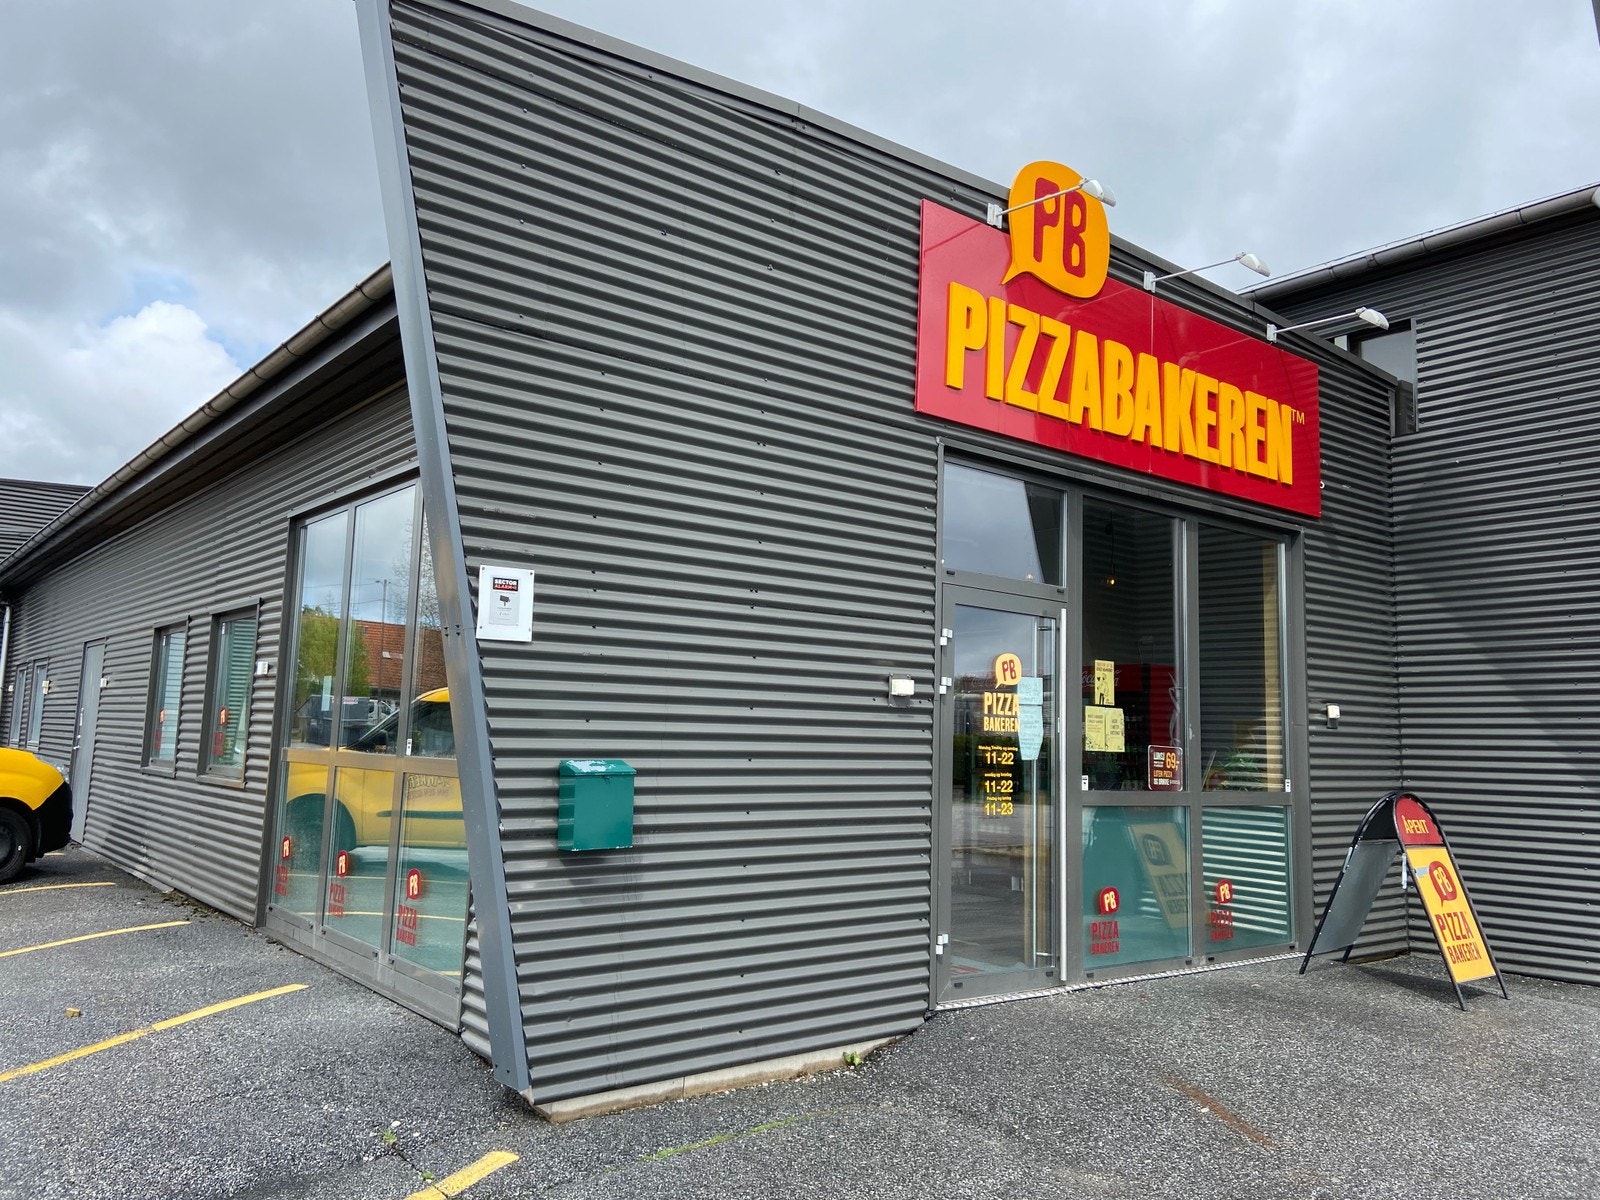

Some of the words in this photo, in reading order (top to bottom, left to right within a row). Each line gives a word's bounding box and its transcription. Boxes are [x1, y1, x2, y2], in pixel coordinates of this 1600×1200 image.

[1033, 177, 1087, 278] PB
[946, 281, 1293, 485] PIZZABAKEREN
[1001, 659, 1017, 681] PB
[984, 692, 1019, 716] PIZZA
[983, 716, 1019, 732] BAKEREN
[985, 751, 1014, 764] 11-22
[984, 780, 1013, 793] 11-22
[985, 802, 1013, 816] 11-23
[1401, 815, 1429, 834] ÅPENT
[1433, 866, 1453, 896] PB
[1104, 891, 1117, 911] PB
[1220, 883, 1231, 902] PB
[398, 904, 417, 930] PIZZA
[1435, 911, 1474, 942] PIZZA
[1091, 920, 1119, 940] PIZZA
[1447, 942, 1481, 964] BAKEREN
